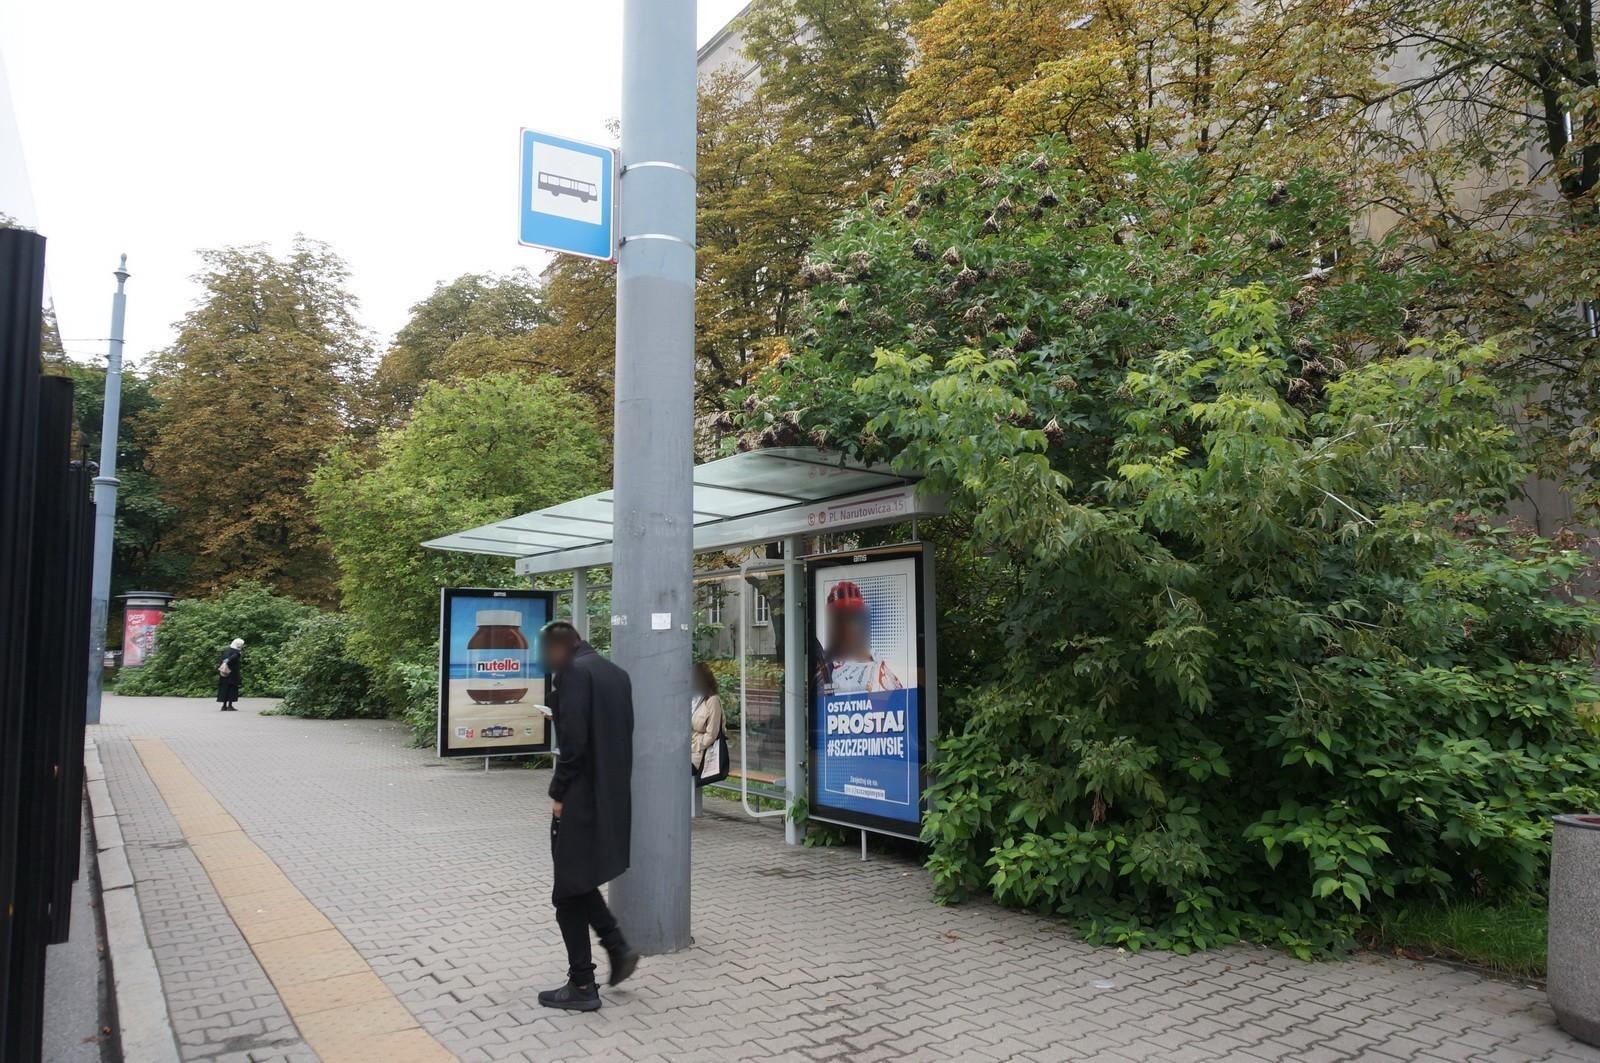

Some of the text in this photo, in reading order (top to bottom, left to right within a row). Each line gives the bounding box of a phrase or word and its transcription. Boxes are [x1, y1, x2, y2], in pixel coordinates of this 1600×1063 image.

[840, 504, 891, 521] Narutowicza
[893, 500, 904, 512] 15
[477, 659, 520, 671] nutella
[827, 699, 873, 713] OSTATNIA
[827, 710, 905, 735] PROSTA!
[827, 736, 904, 759] #SZCZEPIMYSIĘ
